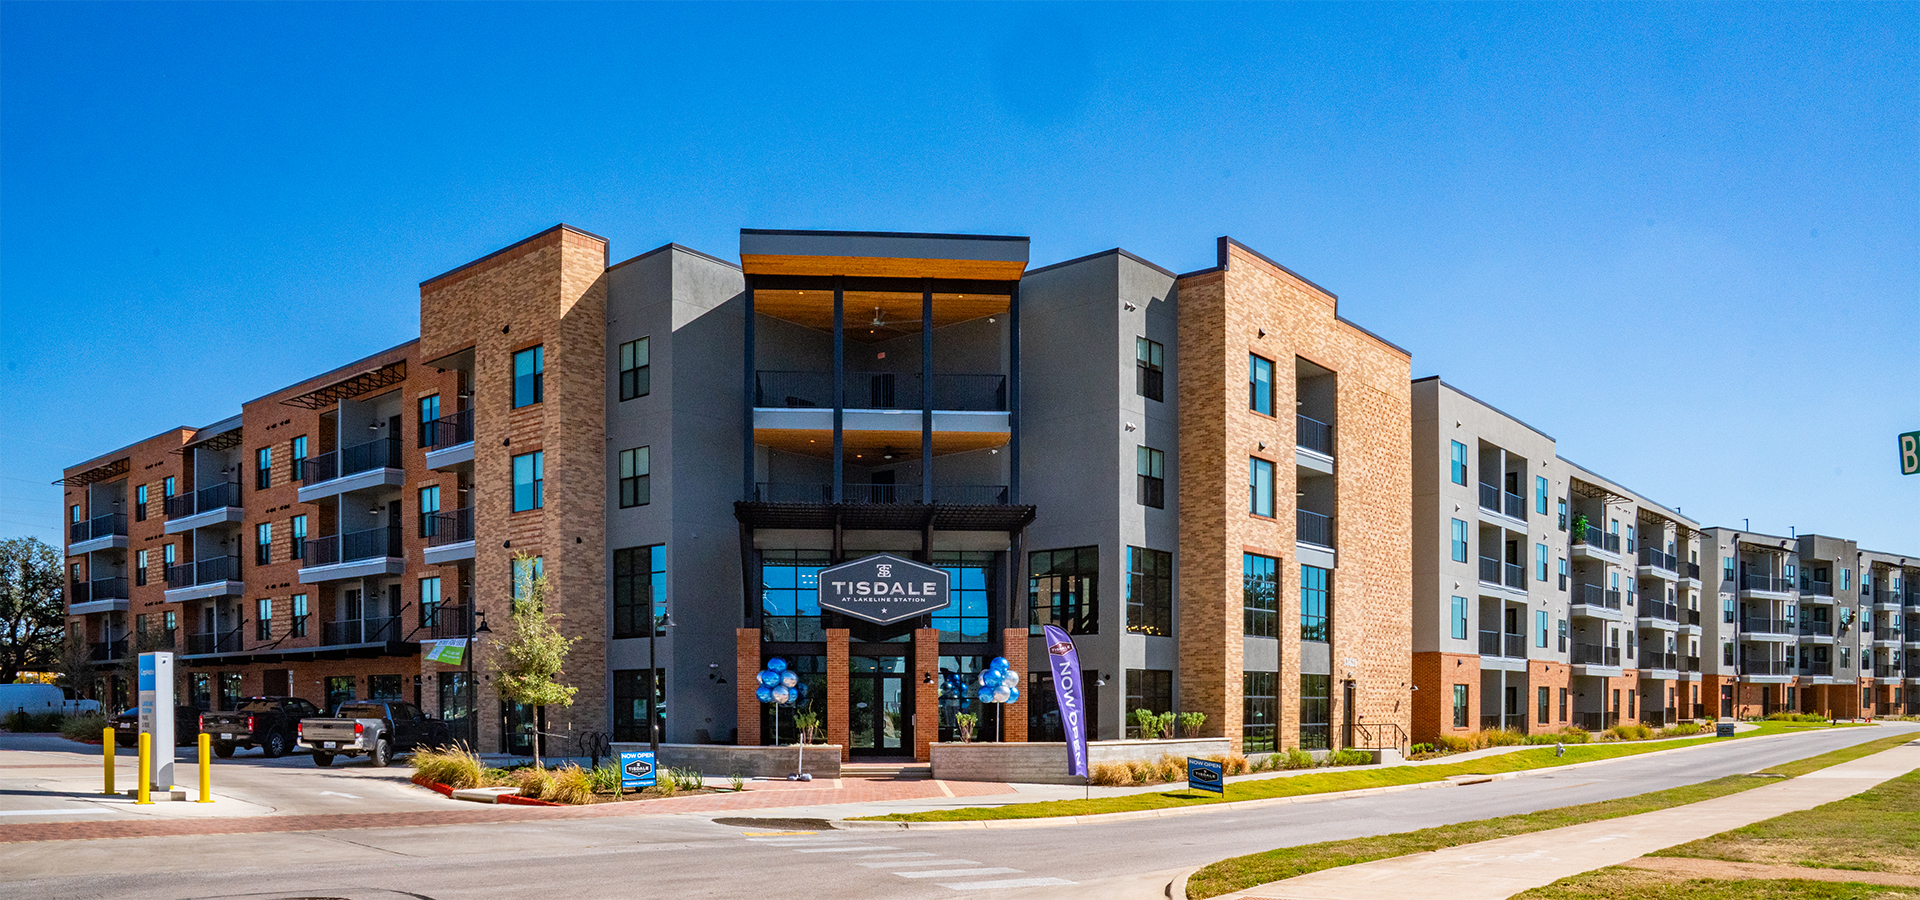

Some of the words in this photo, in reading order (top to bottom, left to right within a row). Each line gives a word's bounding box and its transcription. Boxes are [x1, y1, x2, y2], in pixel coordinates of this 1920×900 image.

[1902, 436, 1920, 473] B
[831, 581, 937, 595] TISDALE
[1059, 661, 1076, 707] NOW
[1069, 711, 1081, 766] OPEN
